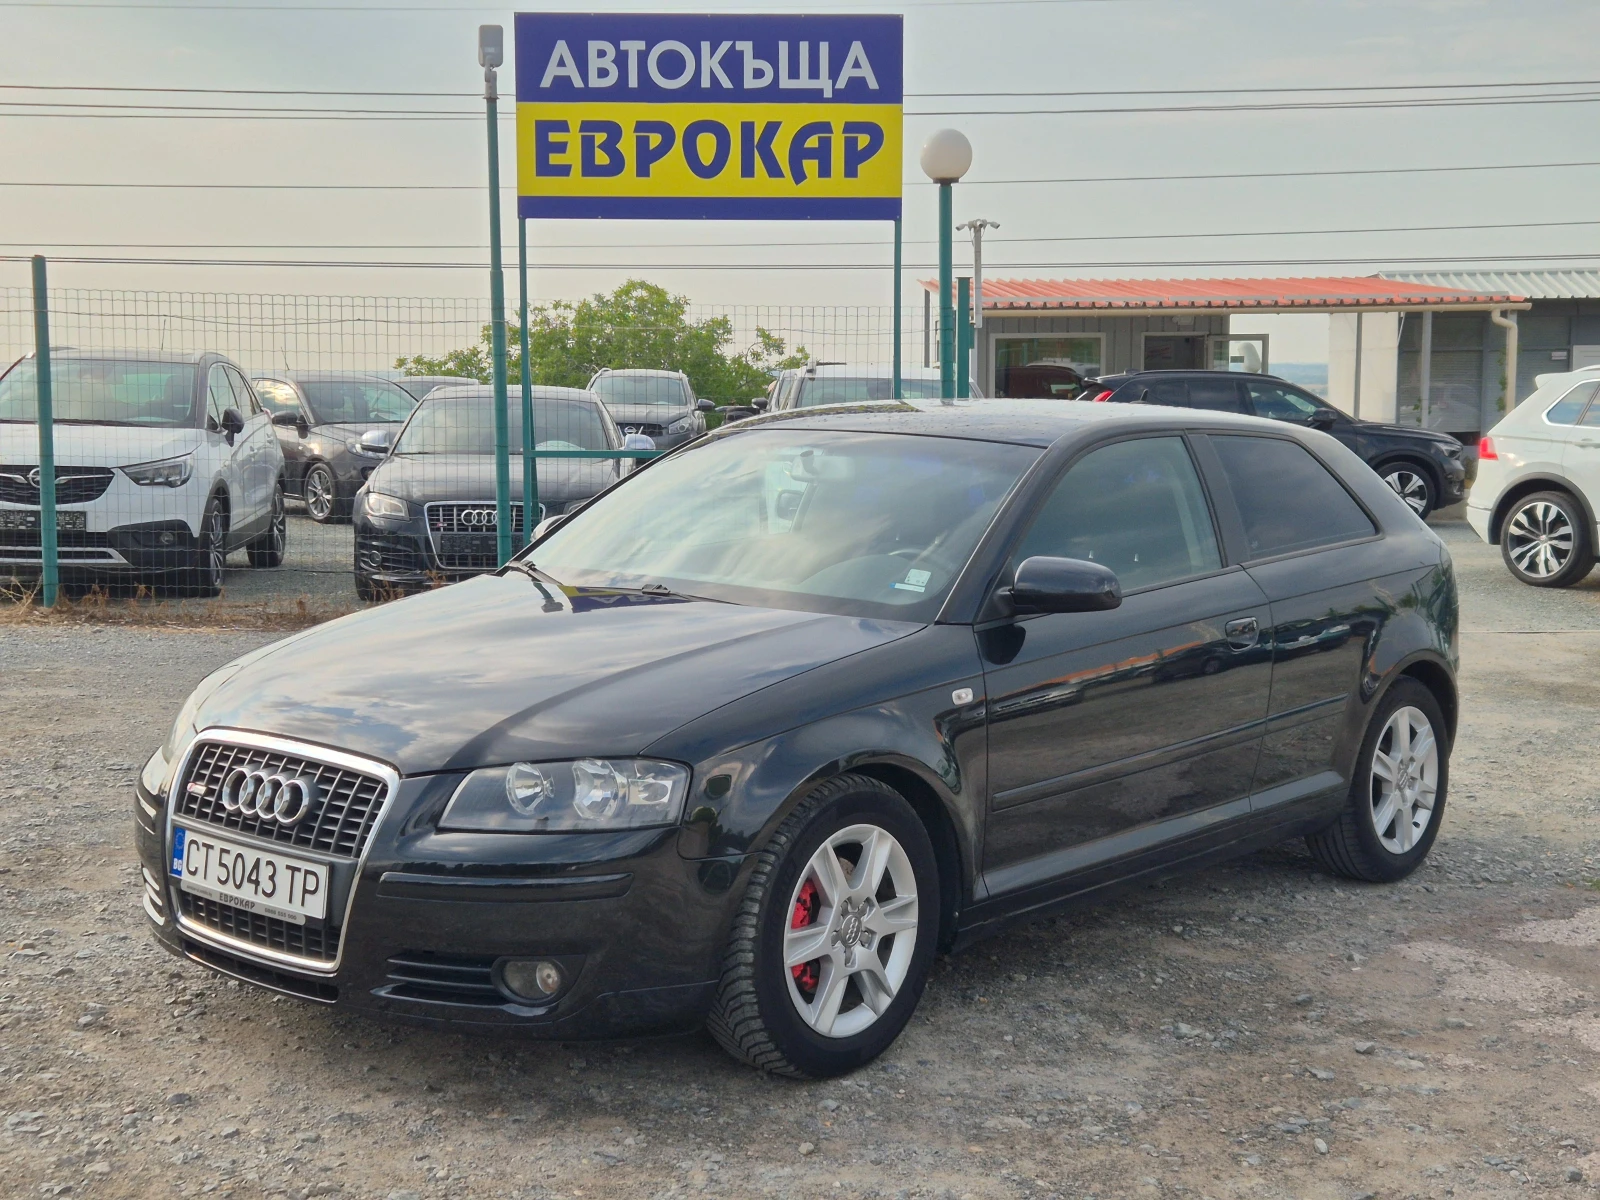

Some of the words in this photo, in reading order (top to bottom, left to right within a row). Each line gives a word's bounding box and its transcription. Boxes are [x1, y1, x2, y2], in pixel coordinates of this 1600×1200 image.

[539, 39, 880, 98] АВТОКЪЩА
[534, 119, 885, 186] ЕВРОКАР
[172, 857, 183, 872] BG
[186, 838, 215, 880] CT
[217, 847, 277, 898] 5043
[285, 864, 320, 908] TP
